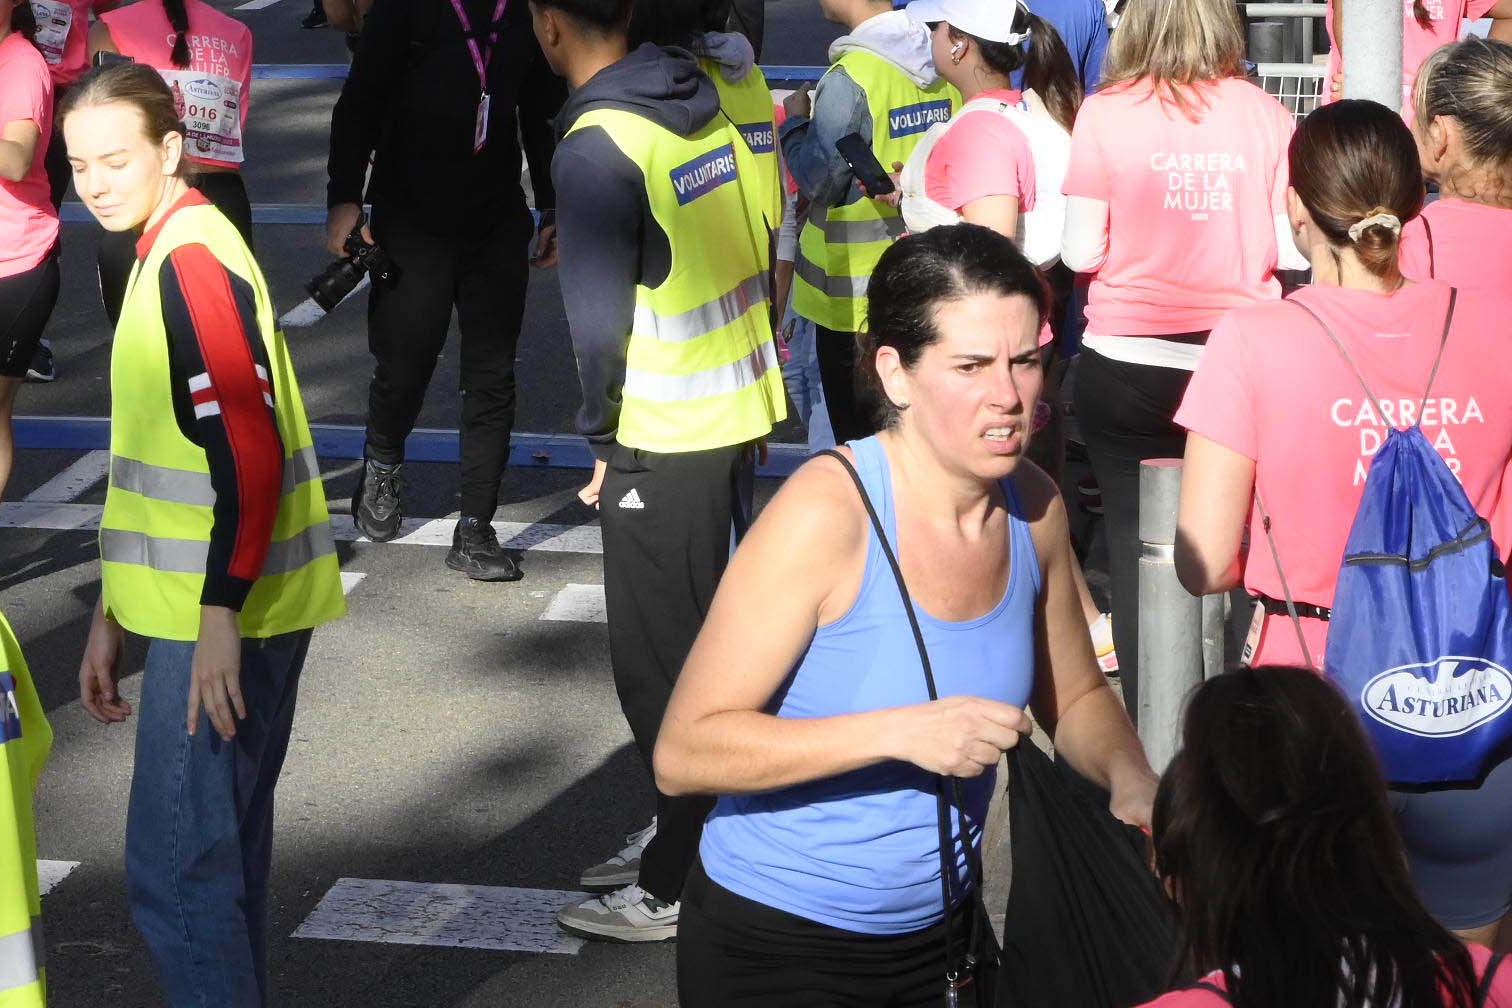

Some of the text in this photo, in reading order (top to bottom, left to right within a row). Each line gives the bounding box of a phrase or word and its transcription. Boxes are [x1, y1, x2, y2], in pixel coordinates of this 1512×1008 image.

[167, 35, 239, 58] CRRERA
[210, 48, 228, 66] LA
[189, 104, 217, 120] 016
[1151, 153, 1247, 172] CARRERA
[1168, 173, 1229, 191] DE LA
[1164, 192, 1233, 212] MUJER
[1330, 398, 1484, 428] CARRERA
[1376, 683, 1505, 718] ASTURIANA
